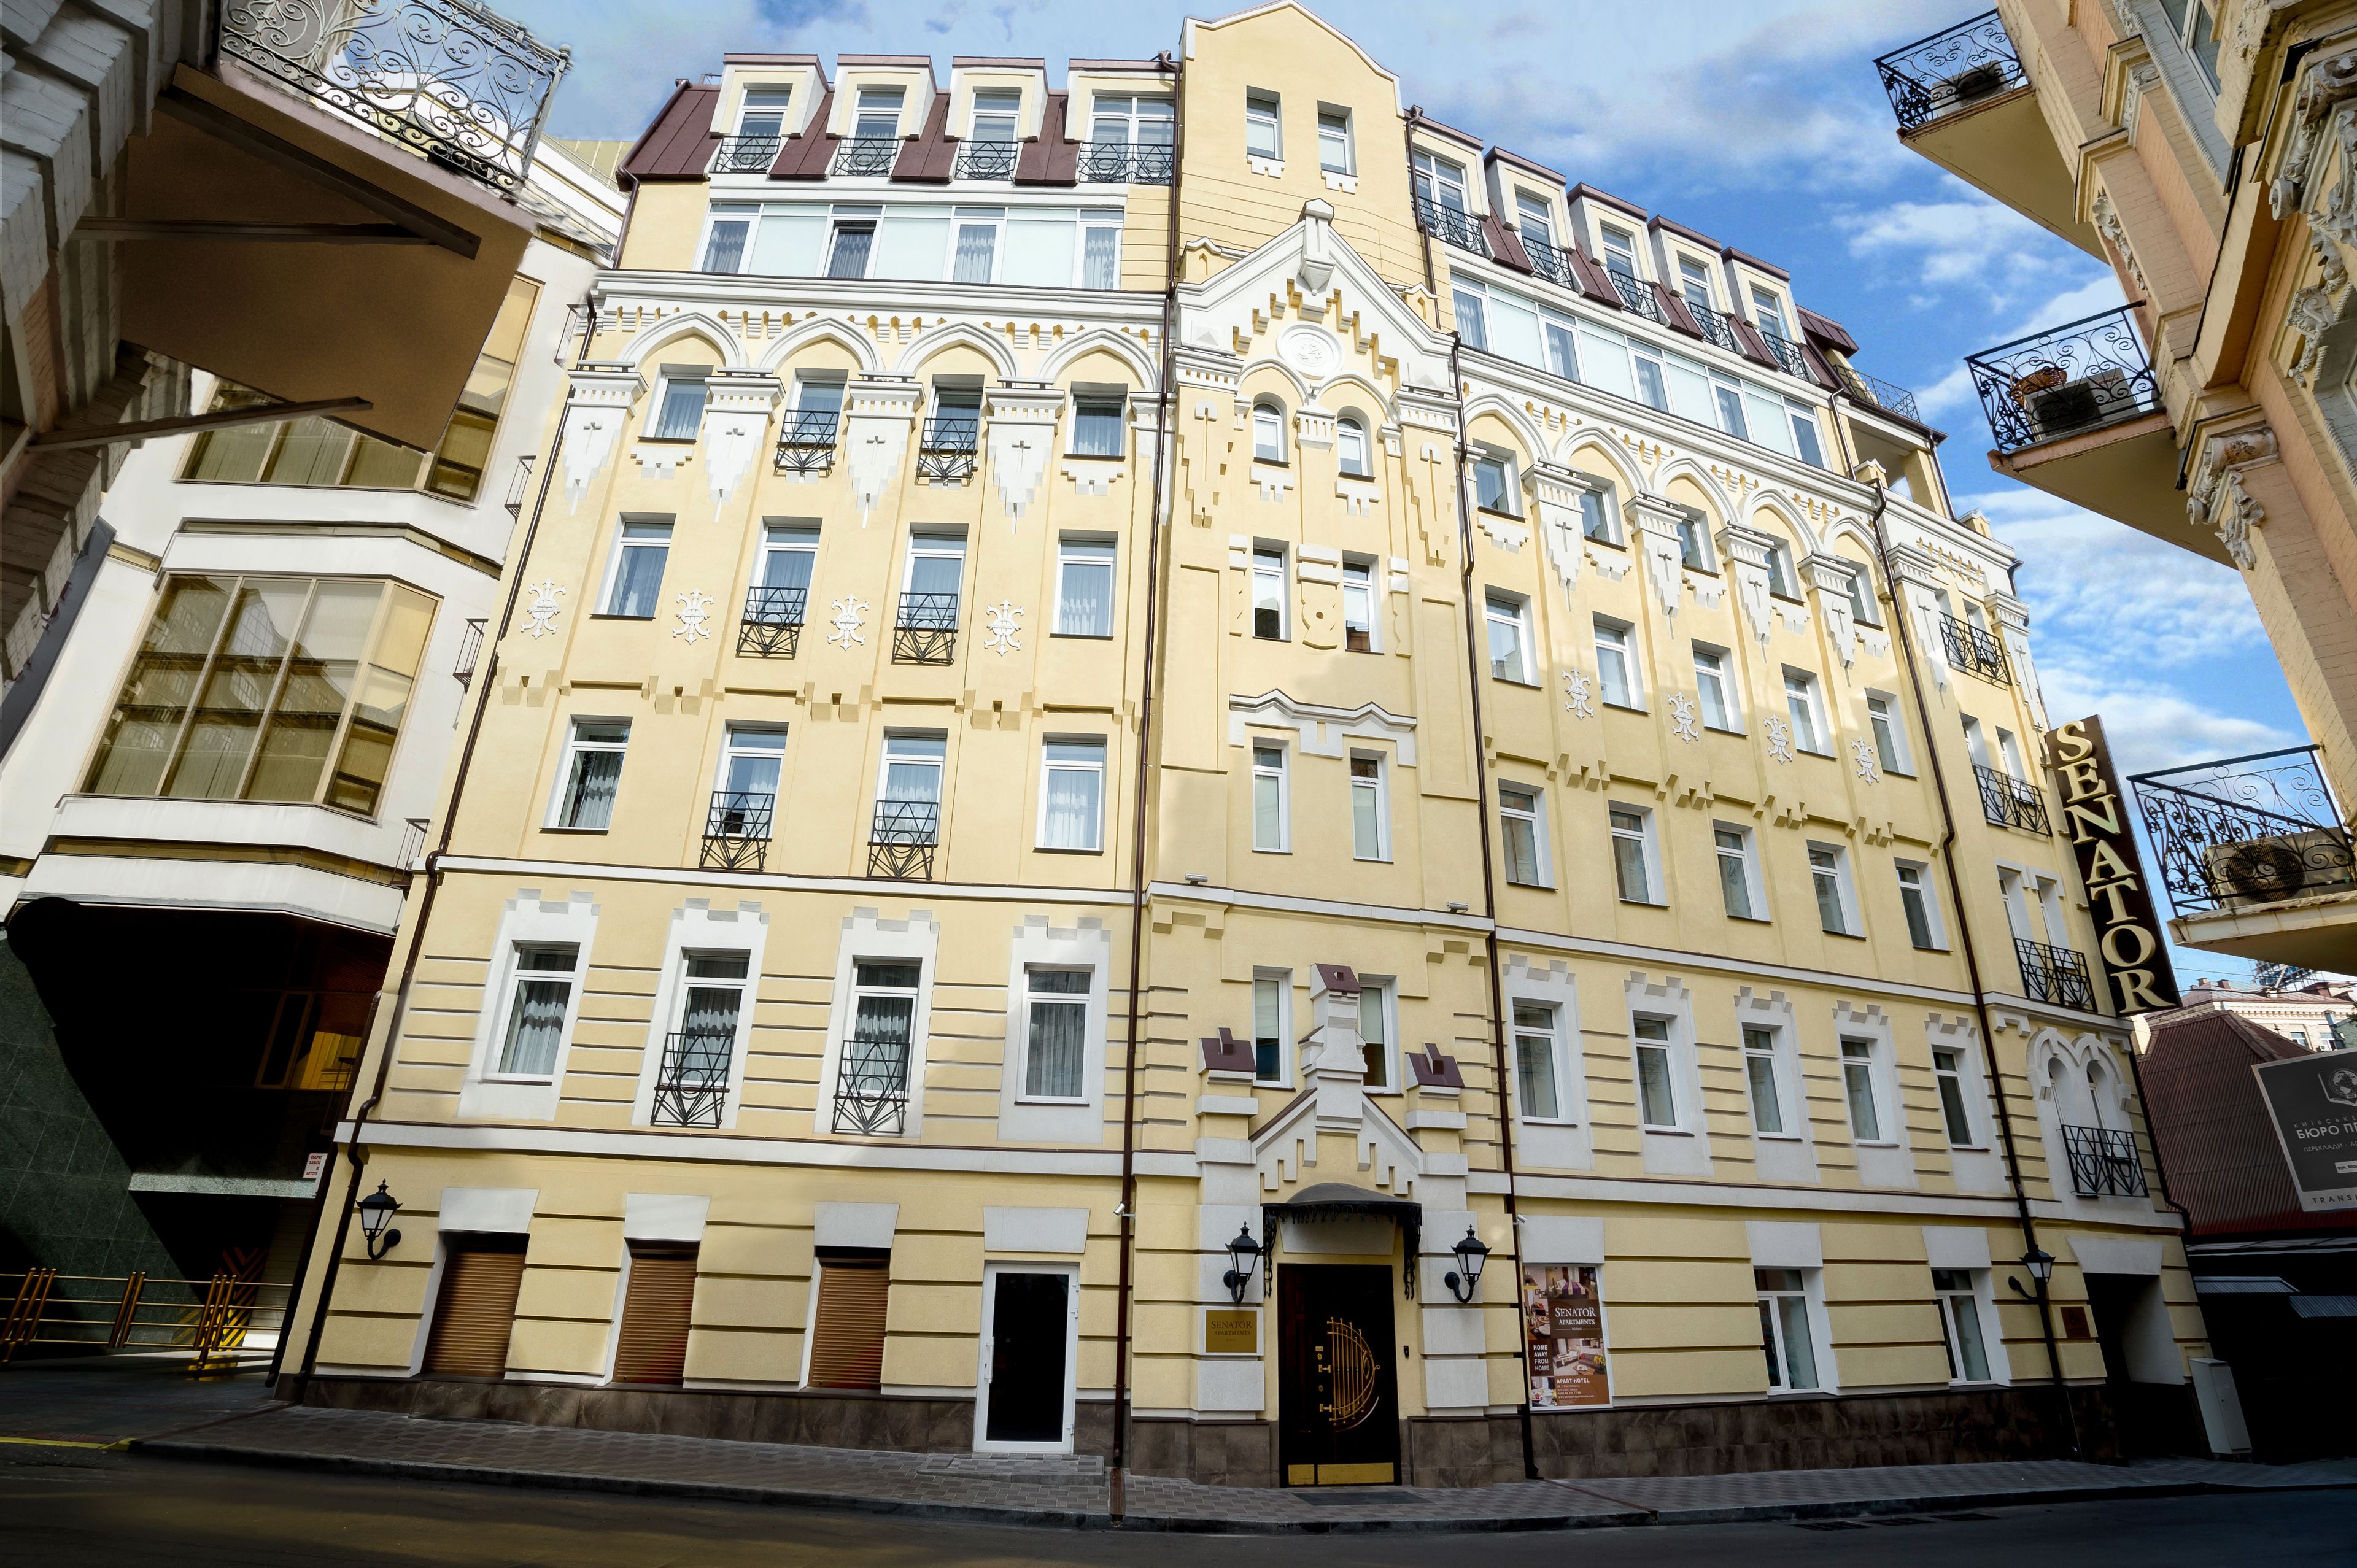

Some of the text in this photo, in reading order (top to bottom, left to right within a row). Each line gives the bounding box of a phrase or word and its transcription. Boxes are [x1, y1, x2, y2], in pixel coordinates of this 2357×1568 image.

[2056, 720, 2177, 1014] SENATOR
[2296, 1125, 2339, 1139] БЮРО
[2304, 1143, 2343, 1152] ПЕРЕКЛАДИ
[1555, 1307, 1596, 1318] SENATOR
